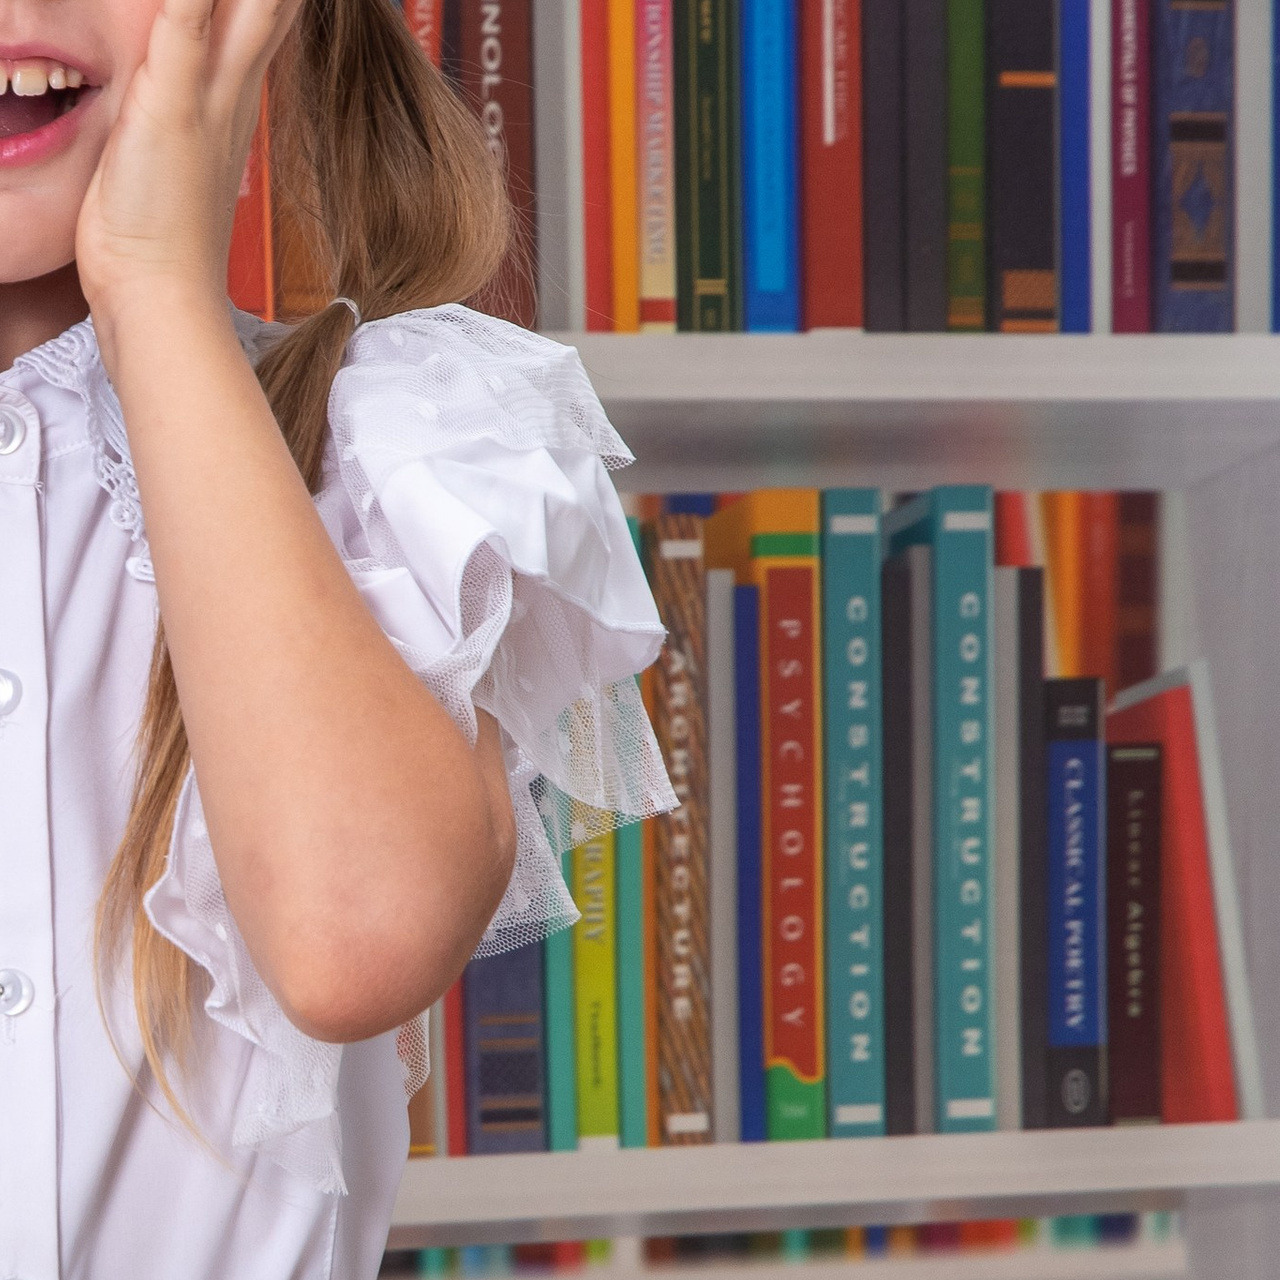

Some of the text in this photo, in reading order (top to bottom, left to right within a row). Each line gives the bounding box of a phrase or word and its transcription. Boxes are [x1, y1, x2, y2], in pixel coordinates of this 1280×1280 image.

[669, 648, 693, 1023] ARCHITECTURE
[777, 617, 804, 1029] PSYCHOLOGY
[846, 596, 870, 1062] CONSTRUCTION
[959, 591, 983, 1057] CONSTRUCTION
